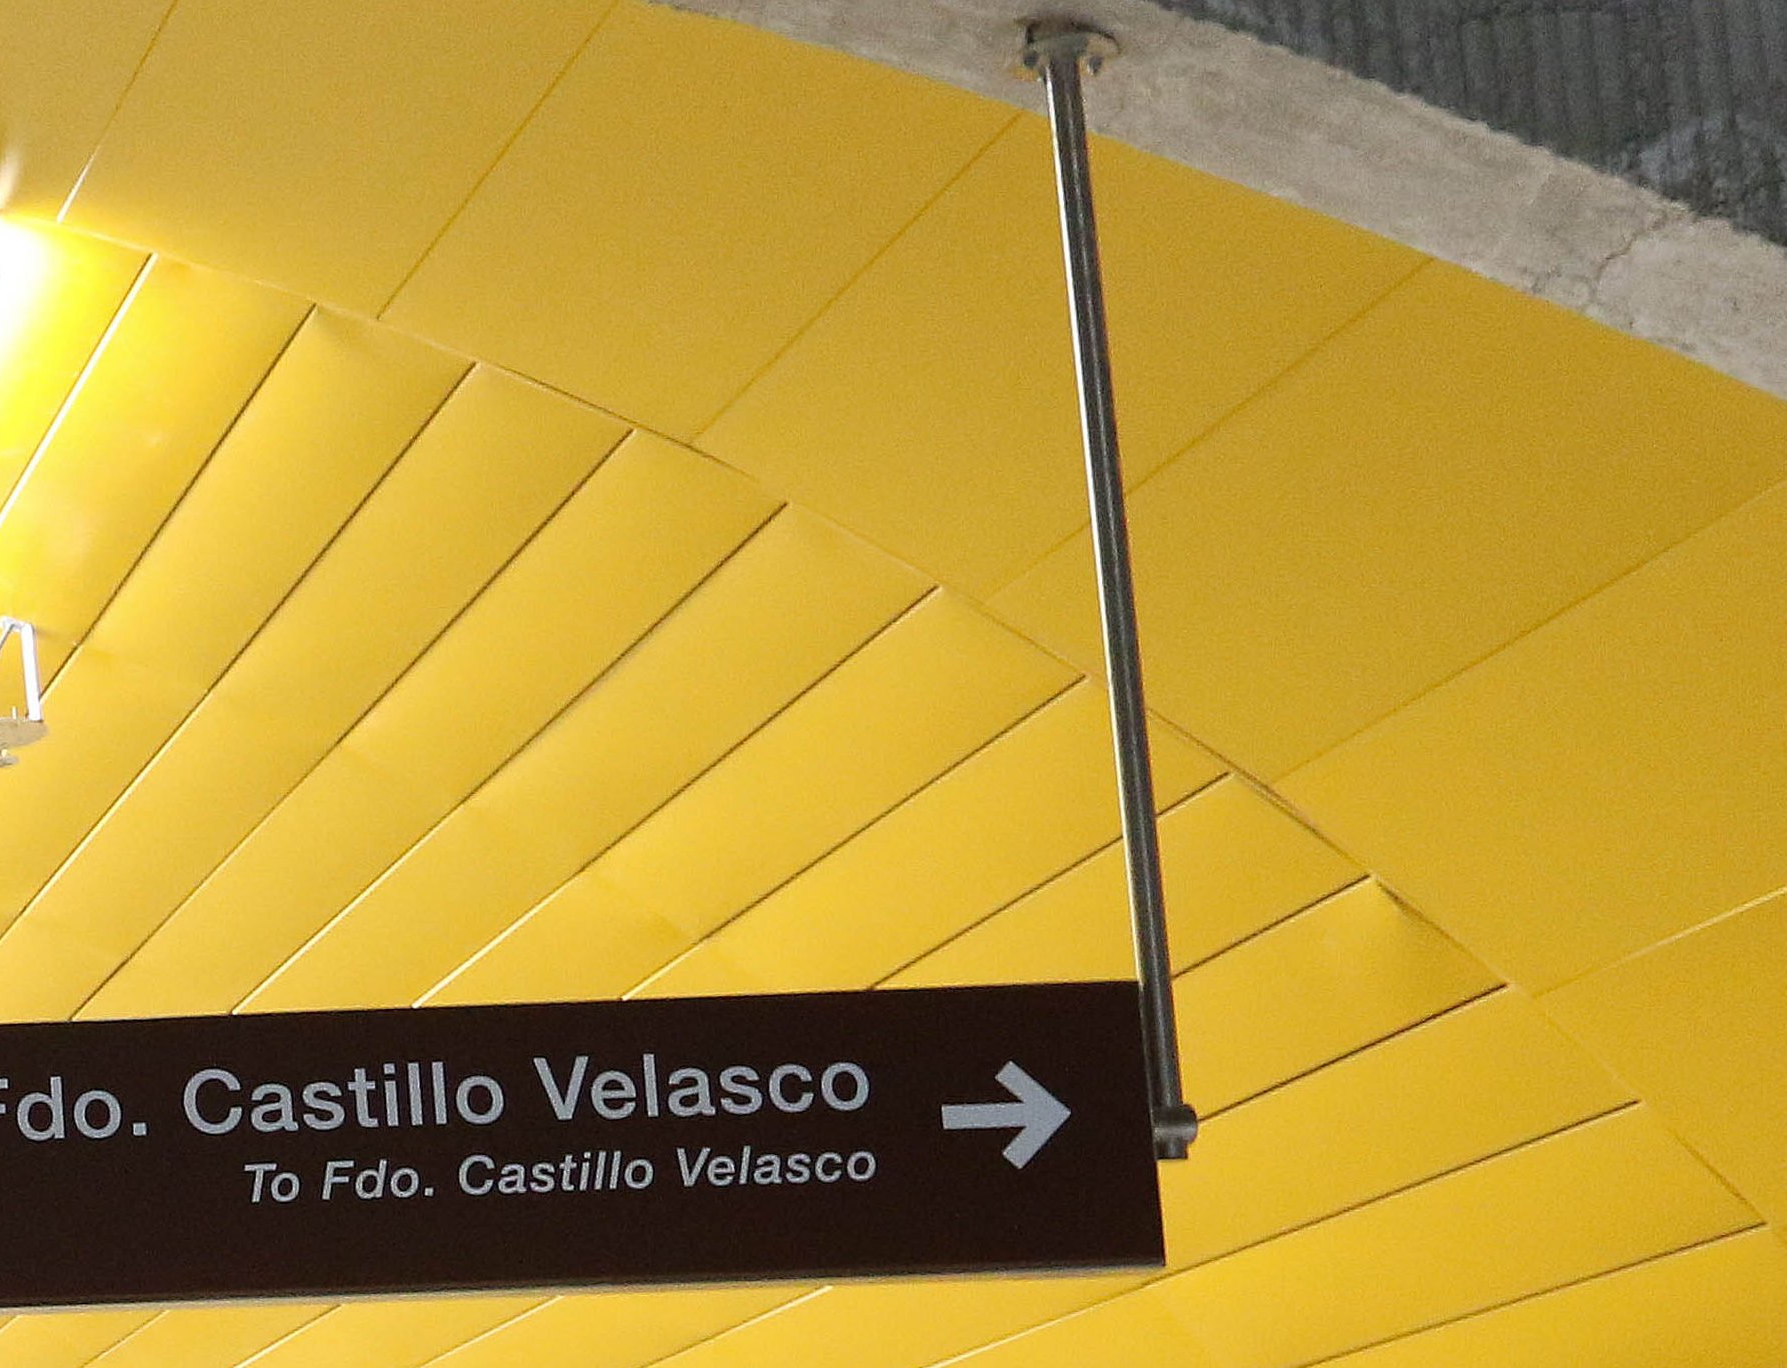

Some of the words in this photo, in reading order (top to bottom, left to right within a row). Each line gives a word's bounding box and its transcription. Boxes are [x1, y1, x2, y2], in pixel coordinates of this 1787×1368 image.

[183, 1061, 504, 1135] Castillo
[533, 1053, 870, 1121] Velasco
[244, 1163, 300, 1203] To
[321, 1159, 434, 1200] Fdo.
[458, 1150, 654, 1196] Castillo
[676, 1145, 876, 1187] Velasco
